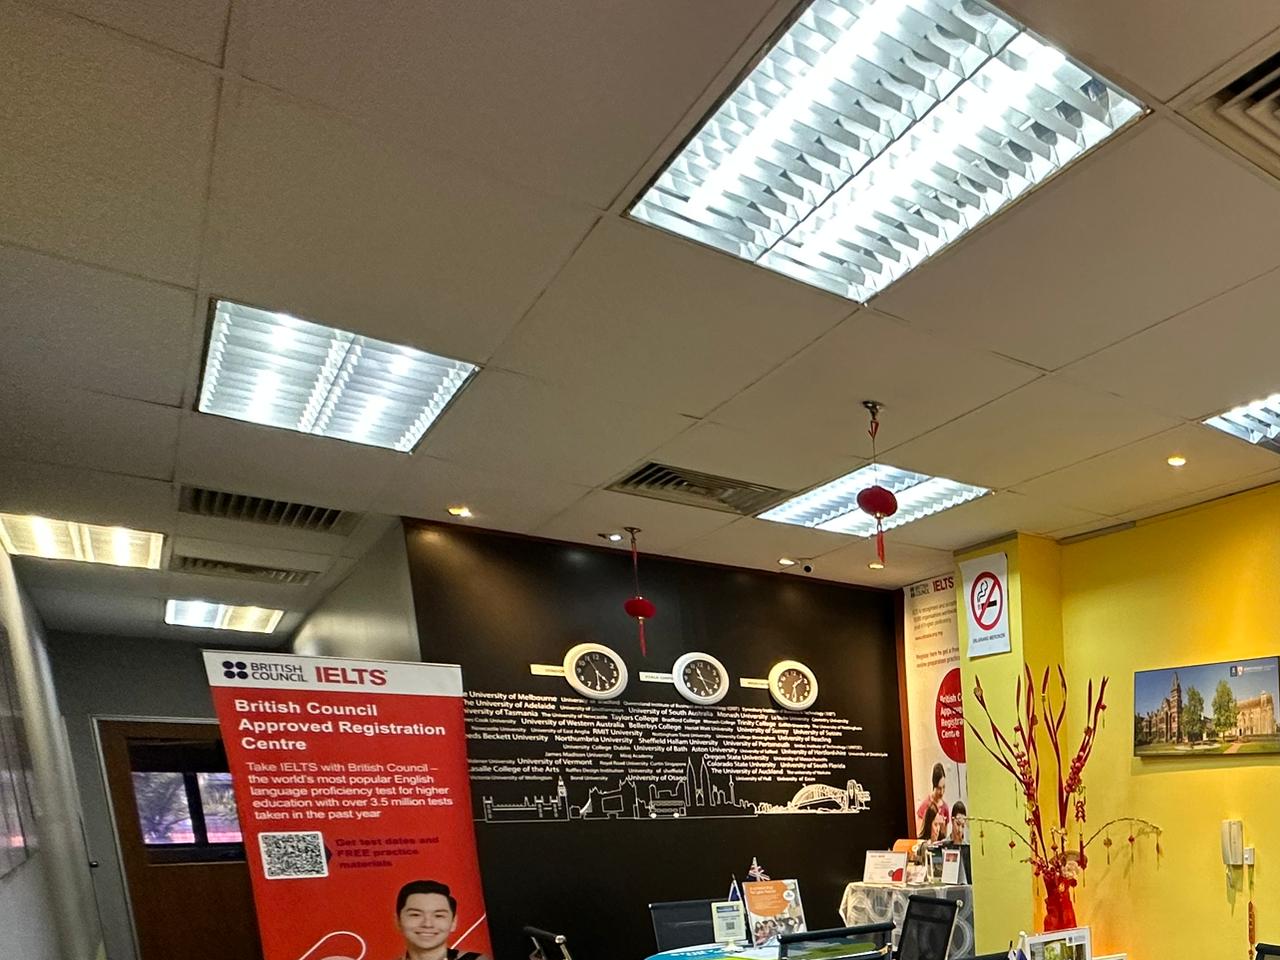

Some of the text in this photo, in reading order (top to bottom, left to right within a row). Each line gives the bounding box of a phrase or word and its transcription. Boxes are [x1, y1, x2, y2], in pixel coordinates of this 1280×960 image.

[933, 577, 954, 592] IELTS
[250, 662, 386, 685] BRITISH IELTS
[252, 672, 308, 682] COUNCIL
[469, 691, 507, 700] University
[518, 694, 557, 702] Melbourne
[234, 699, 378, 716] British Council
[476, 700, 513, 709] University
[504, 709, 538, 717] Tasmania
[628, 708, 660, 716] University
[521, 718, 556, 726] University
[611, 714, 633, 722] Taylors
[634, 715, 658, 723] College
[238, 718, 446, 736] Approved Registration
[629, 722, 657, 730] Bellerbys
[756, 720, 776, 728] College
[611, 730, 642, 738] University
[737, 726, 764, 734] University
[512, 734, 548, 742] University
[600, 736, 632, 744] University
[242, 738, 306, 750] Centre
[723, 740, 752, 748] University
[518, 756, 553, 764] University
[704, 754, 726, 762] Oregon
[246, 762, 428, 772] Take IELTS with British Council
[707, 760, 734, 768] Colorado
[749, 761, 776, 769] University
[780, 762, 806, 770] University
[493, 766, 520, 774] College
[723, 768, 750, 776] University
[248, 775, 434, 787] the world's most popular English
[250, 786, 449, 798] language proficiency test for higher
[252, 798, 454, 808] education with over 3.5 million tests
[255, 810, 382, 822] taken in the past year
[336, 838, 356, 846] Get
[360, 838, 382, 846] test
[386, 837, 416, 845] dates
[337, 848, 419, 858] FREE practice
[340, 860, 392, 868] materials
